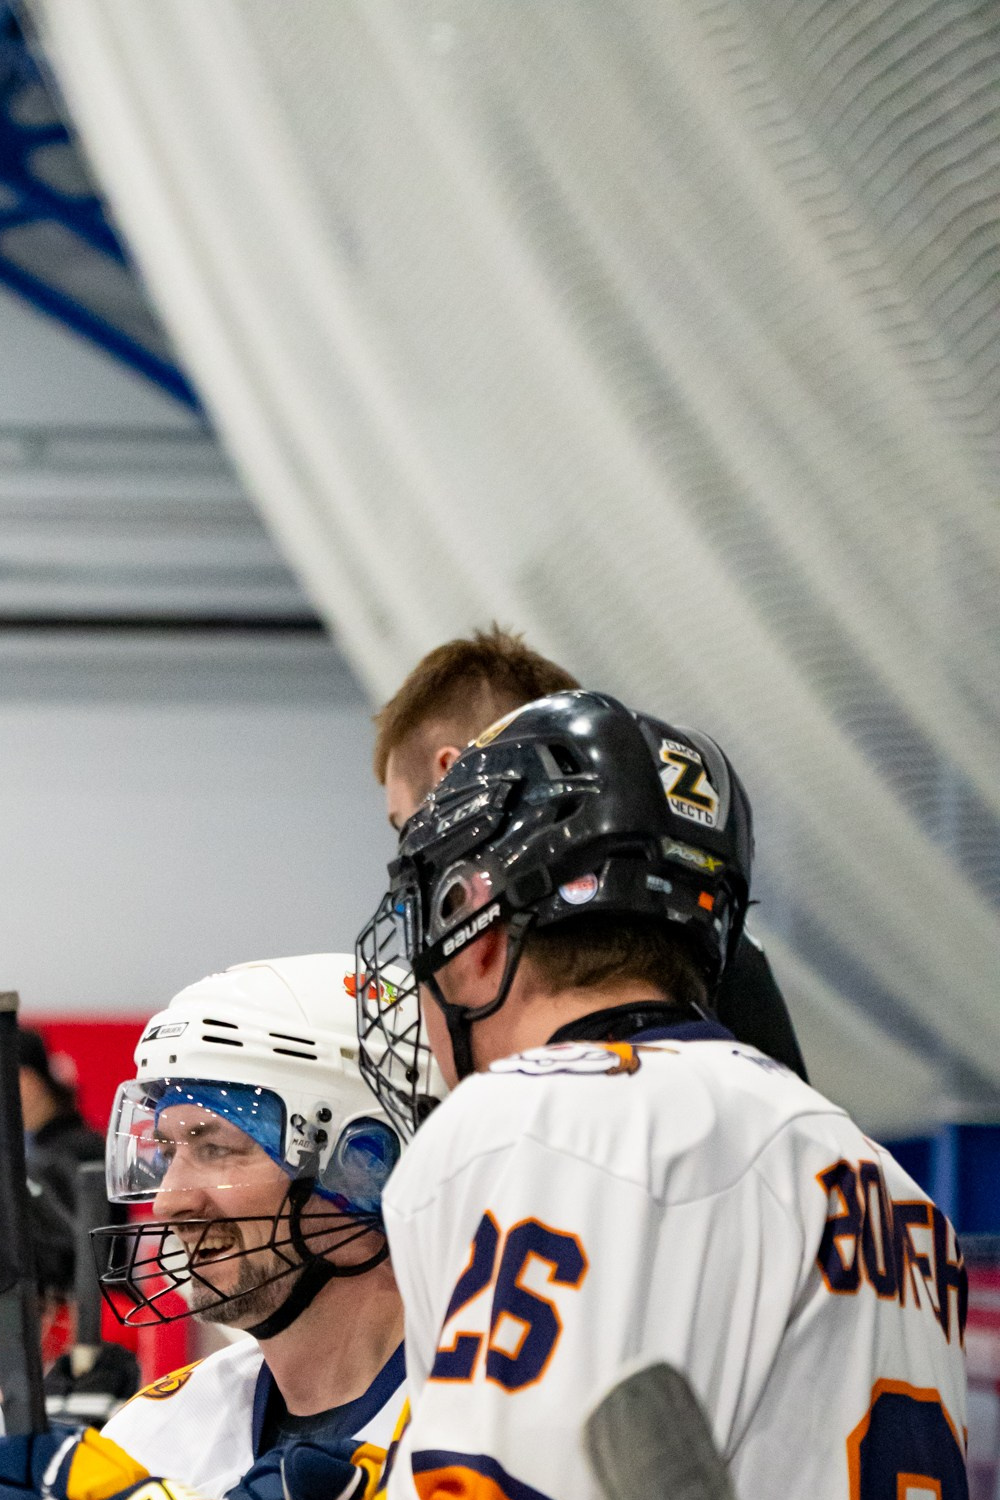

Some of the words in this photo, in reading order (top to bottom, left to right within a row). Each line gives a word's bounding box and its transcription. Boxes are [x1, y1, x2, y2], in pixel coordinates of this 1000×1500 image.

[671, 799, 713, 825] ЧЕСТЬ
[443, 903, 500, 957] BAUER
[427, 1208, 590, 1395] 26
